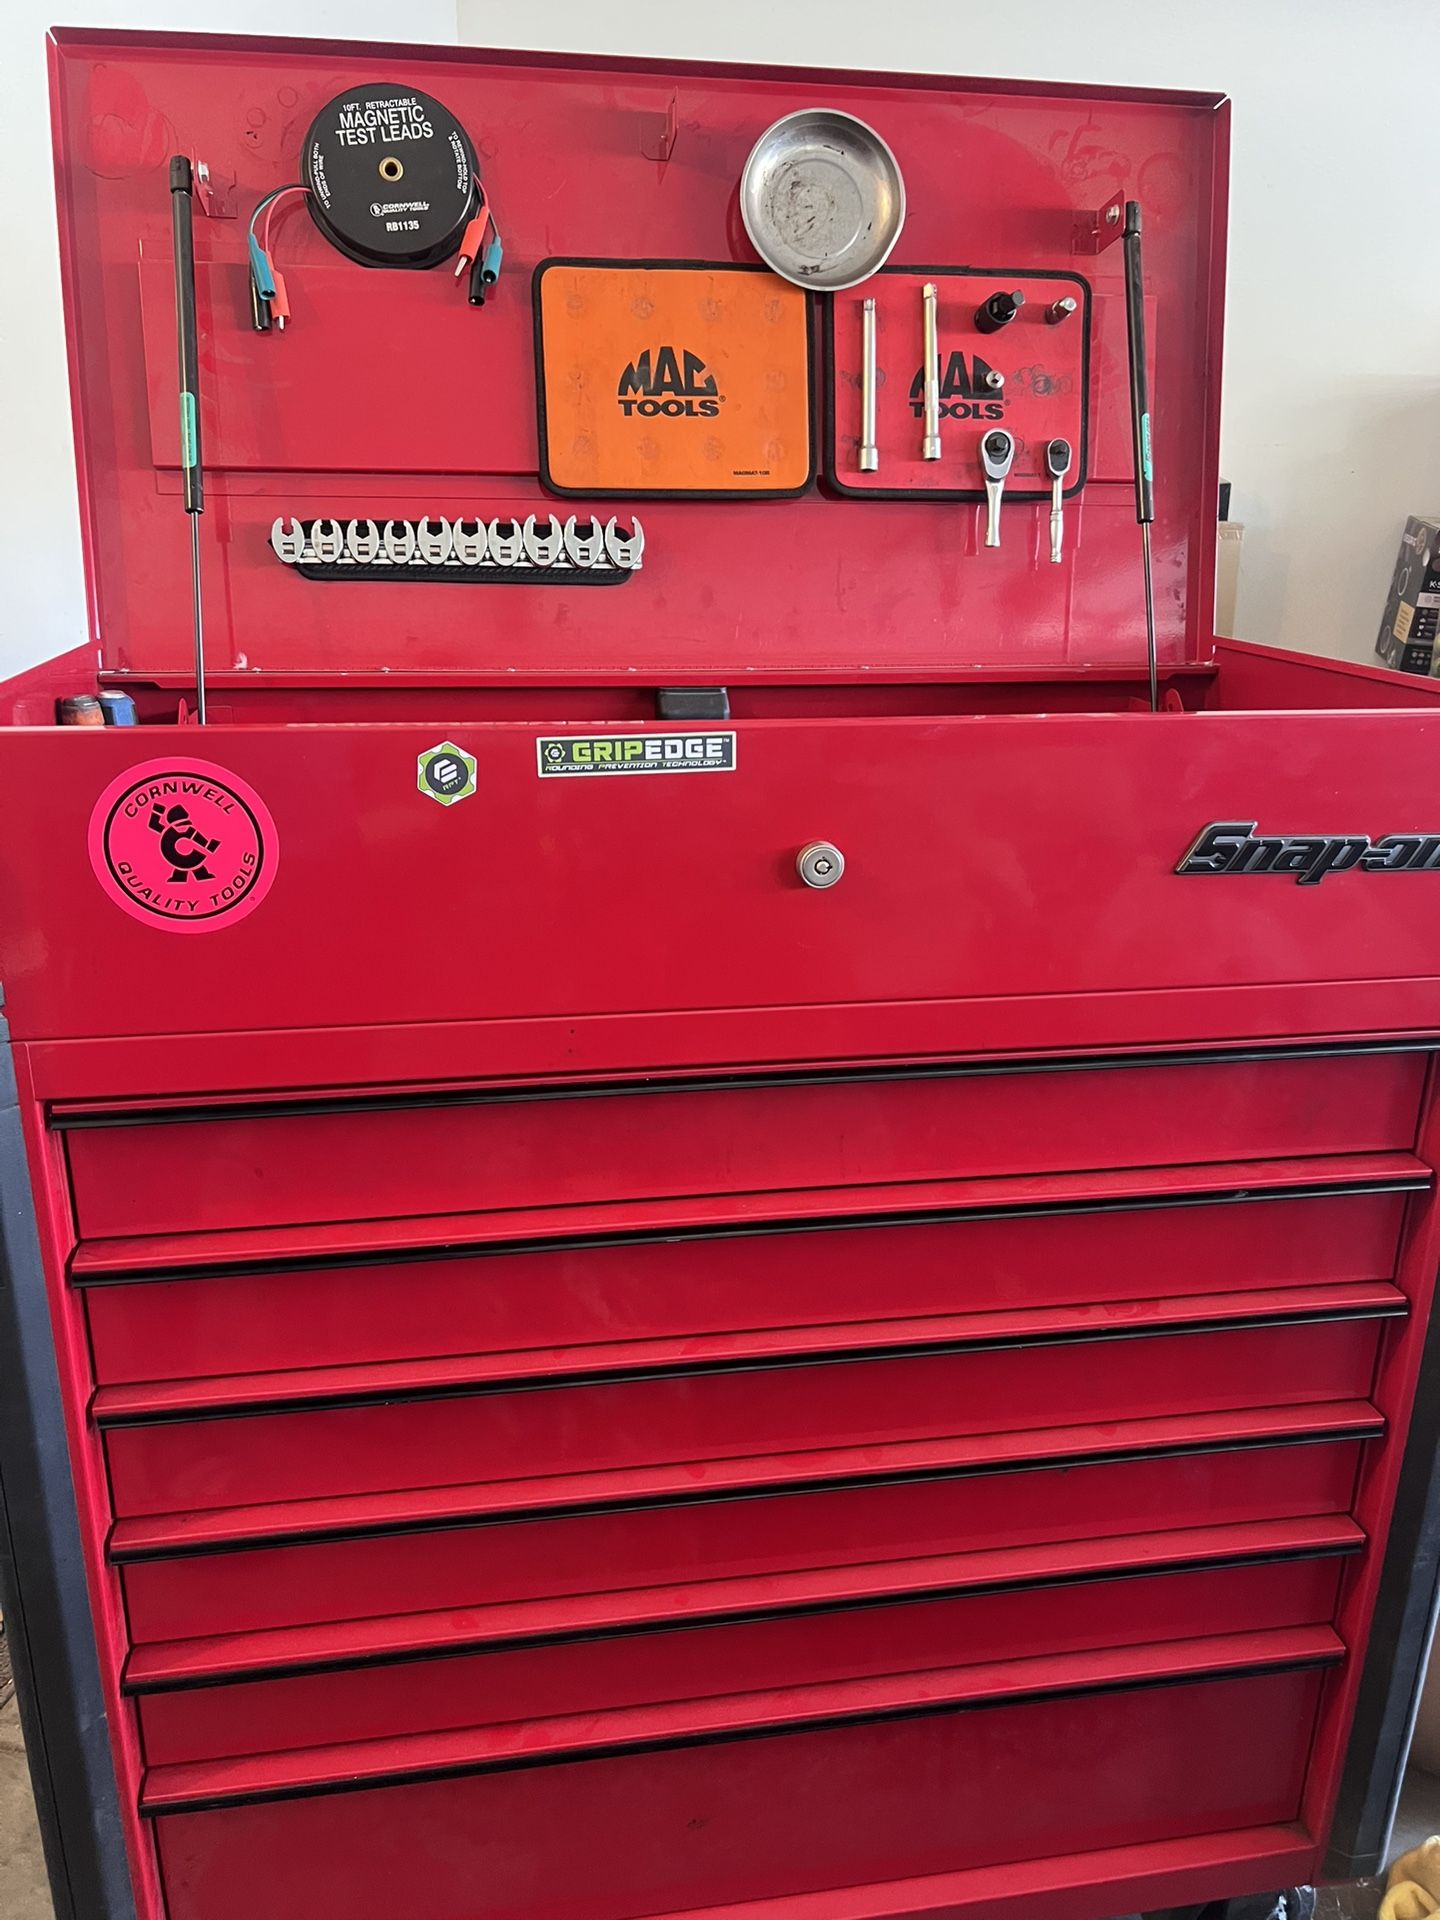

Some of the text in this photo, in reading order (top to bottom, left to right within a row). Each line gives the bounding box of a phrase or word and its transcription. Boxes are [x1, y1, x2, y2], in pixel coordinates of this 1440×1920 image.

[343, 98, 416, 111] 10FT. RETRACTABLE
[339, 106, 424, 128] MAGNETIC
[335, 121, 433, 146] TEST LEADS
[451, 140, 461, 164] ROTATE
[382, 201, 429, 210] CORNWELL
[386, 220, 420, 232] RB1135
[618, 346, 718, 397] MAC
[618, 399, 720, 417] TOOLS
[545, 758, 722, 771] ROUNDING PREVENTION TECHNOLOGY
[125, 781, 234, 818] CORNWELL
[118, 852, 256, 912] QUALITY TOOLS
